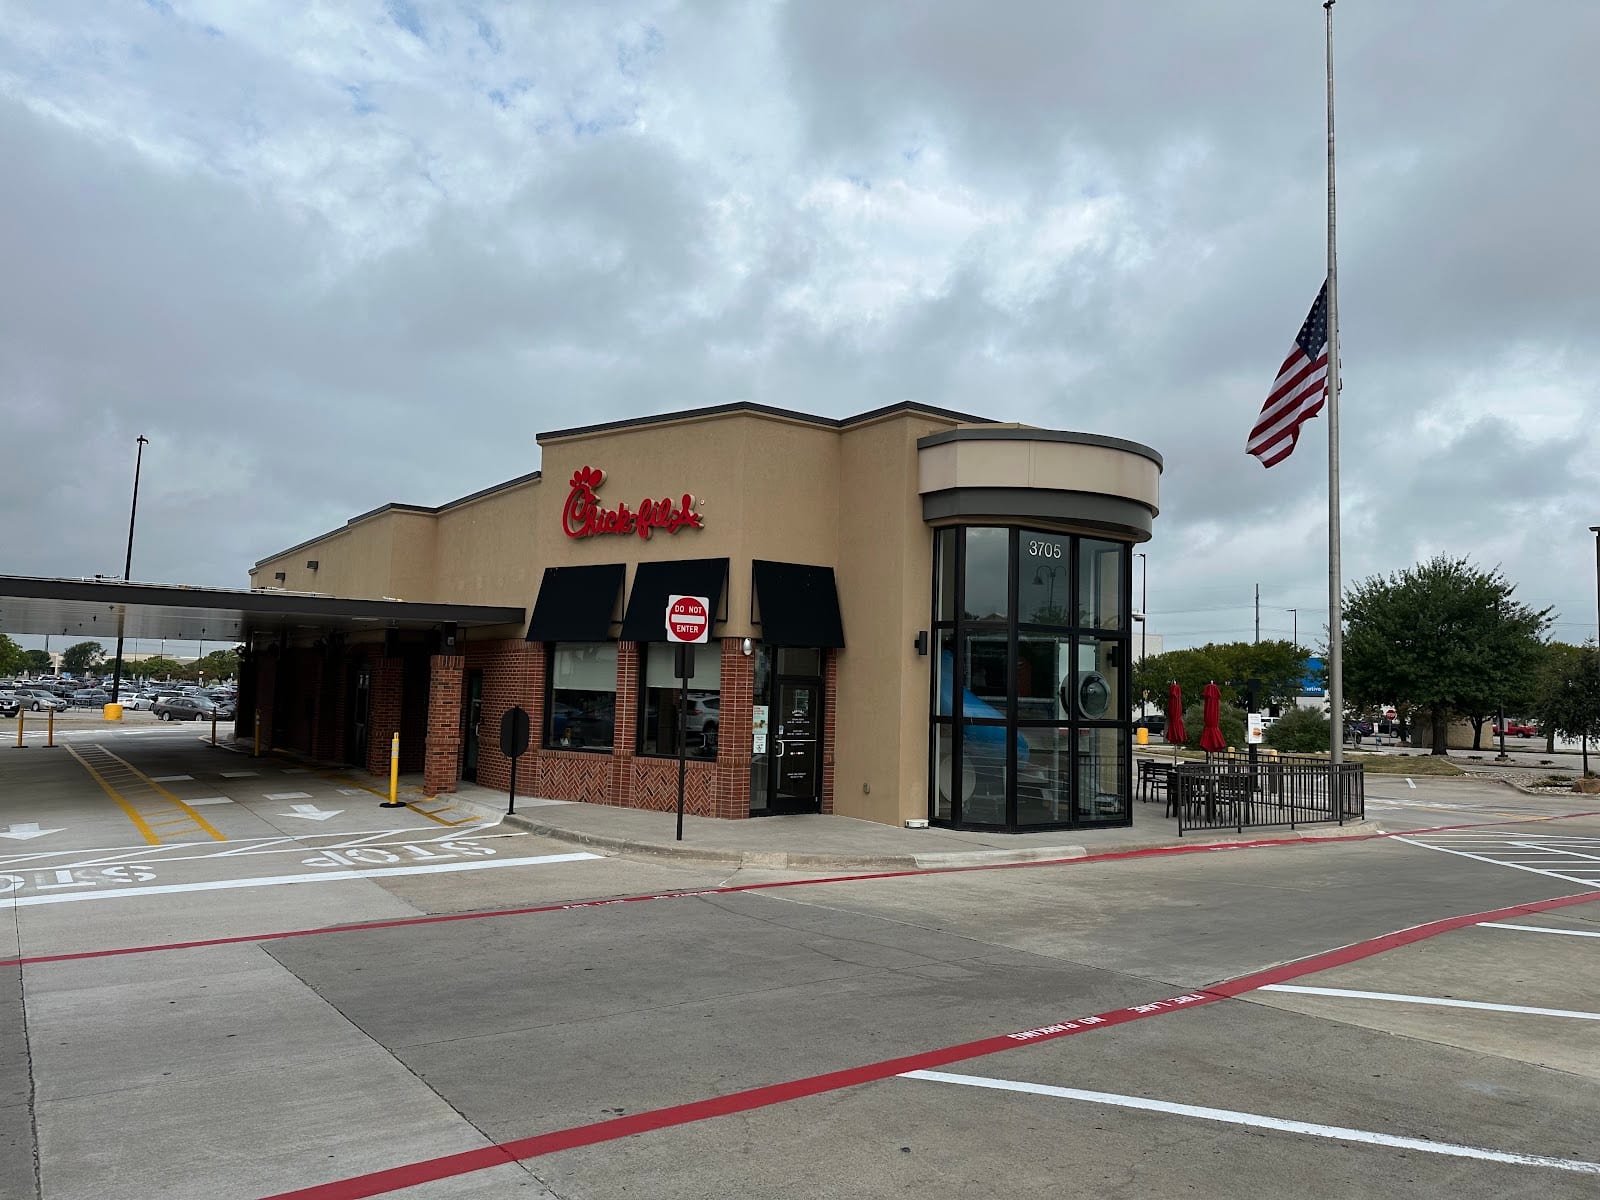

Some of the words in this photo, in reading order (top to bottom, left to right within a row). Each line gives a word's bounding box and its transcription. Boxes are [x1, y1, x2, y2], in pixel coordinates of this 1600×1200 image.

[563, 466, 703, 539] Chick-fil-A
[1029, 540, 1061, 559] 3705
[674, 604, 685, 613] DO
[688, 606, 702, 614] NOT
[676, 624, 699, 633] ENTER
[301, 841, 497, 866] STOP
[1167, 993, 1206, 1005] FIRE
[1127, 1001, 1172, 1014] LANE
[1078, 1015, 1107, 1026] NO
[1007, 1021, 1081, 1041] PARKING
